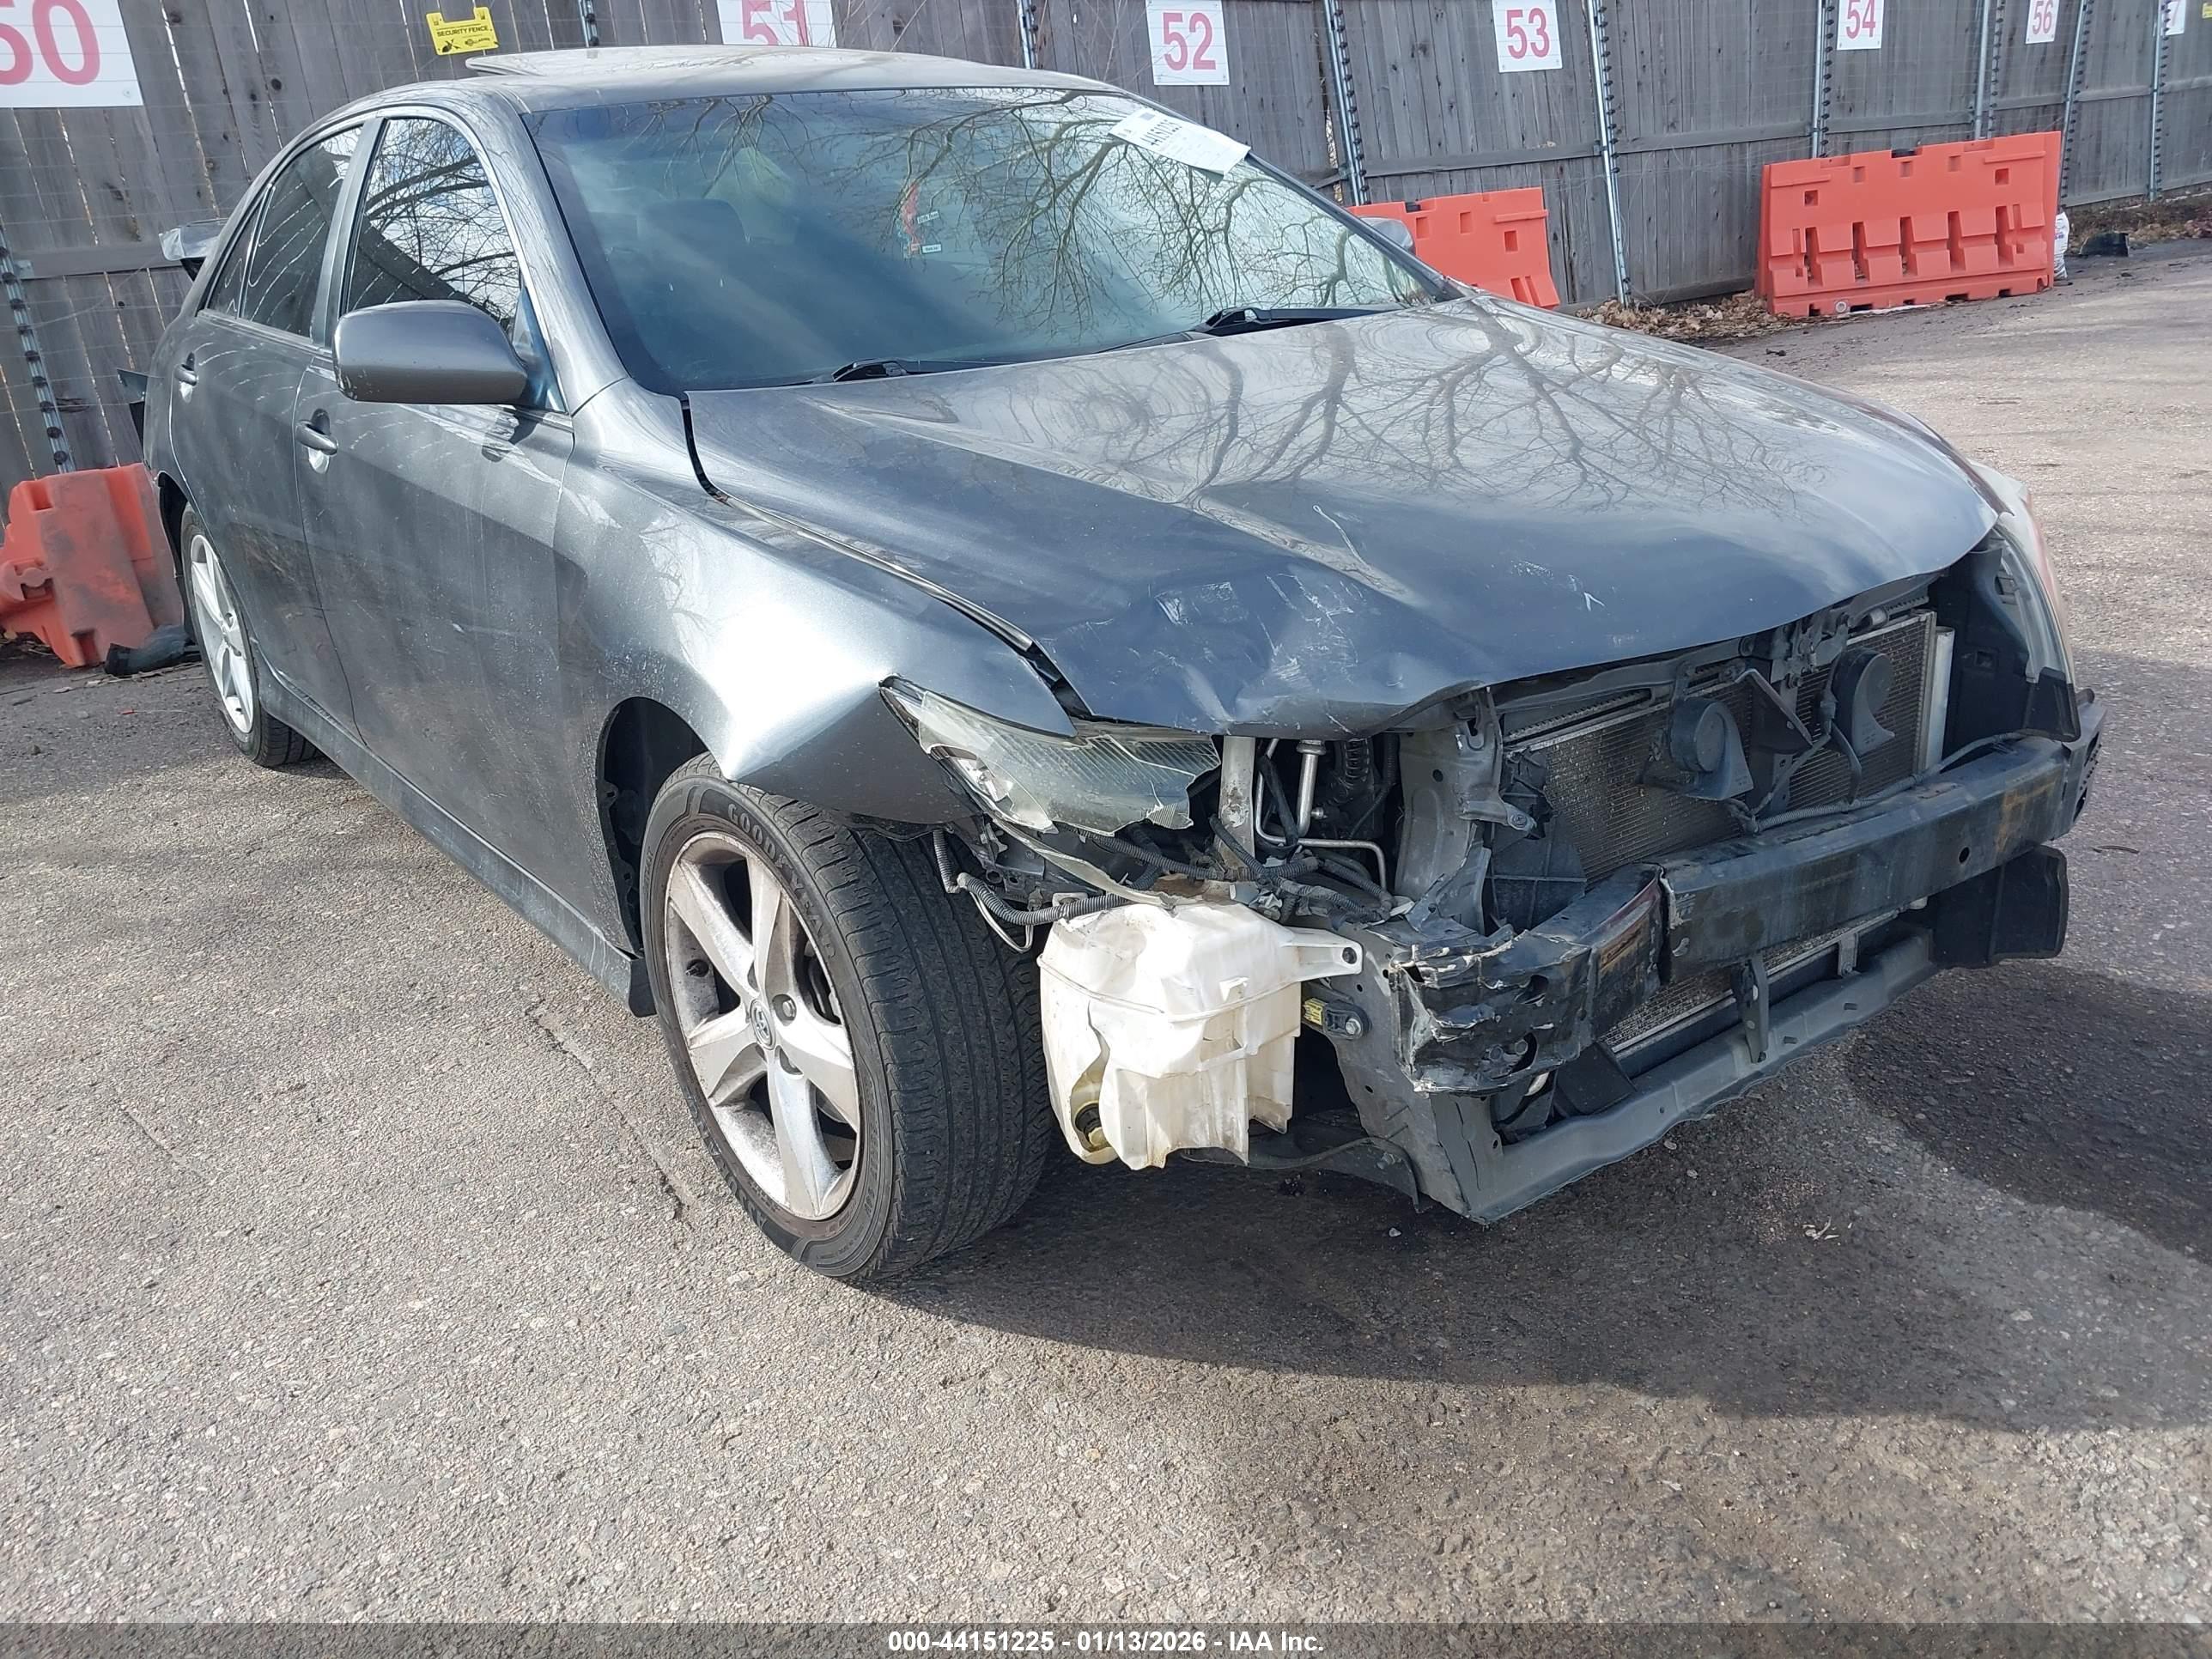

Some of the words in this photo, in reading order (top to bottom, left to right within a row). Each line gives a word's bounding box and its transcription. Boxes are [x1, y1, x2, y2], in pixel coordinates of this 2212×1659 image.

[436, 27, 467, 37] SECURITY
[1506, 8, 1549, 59] 53
[1846, 0, 1876, 40] 54
[2033, 0, 2053, 34] 56
[1163, 12, 1217, 70] 52
